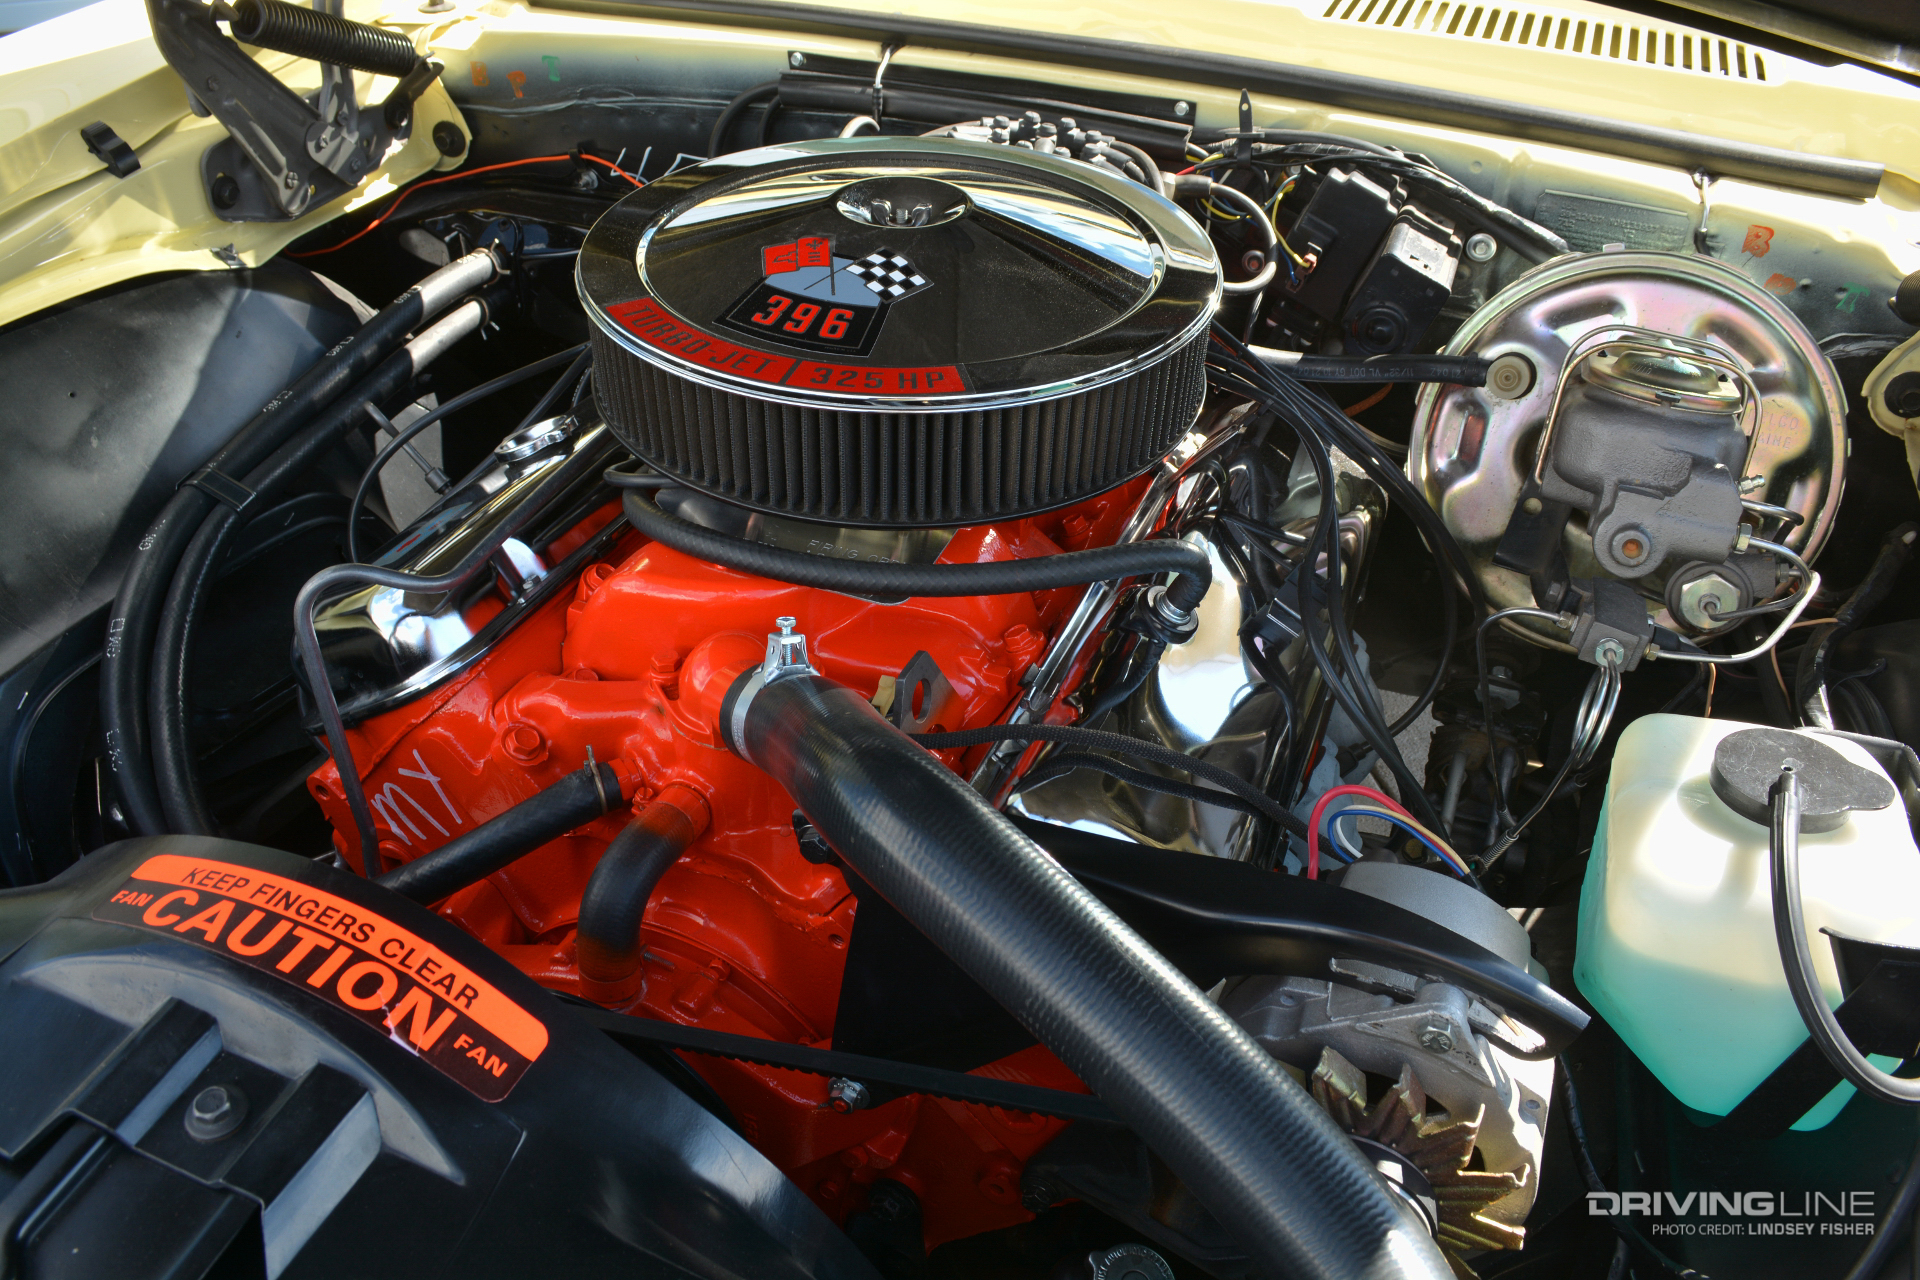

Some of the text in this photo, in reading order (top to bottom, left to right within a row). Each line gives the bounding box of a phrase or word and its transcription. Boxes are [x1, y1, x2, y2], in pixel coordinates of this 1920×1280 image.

[542, 55, 560, 82] T
[751, 294, 855, 340] 396
[622, 305, 945, 390] TURBO-JET 325 HP
[1349, 367, 1366, 378] DOT
[807, 539, 858, 559] FIRING
[181, 867, 480, 1010] KEEP FINGERS CLEAR
[110, 889, 509, 1079] FAN CAUTION FAN
